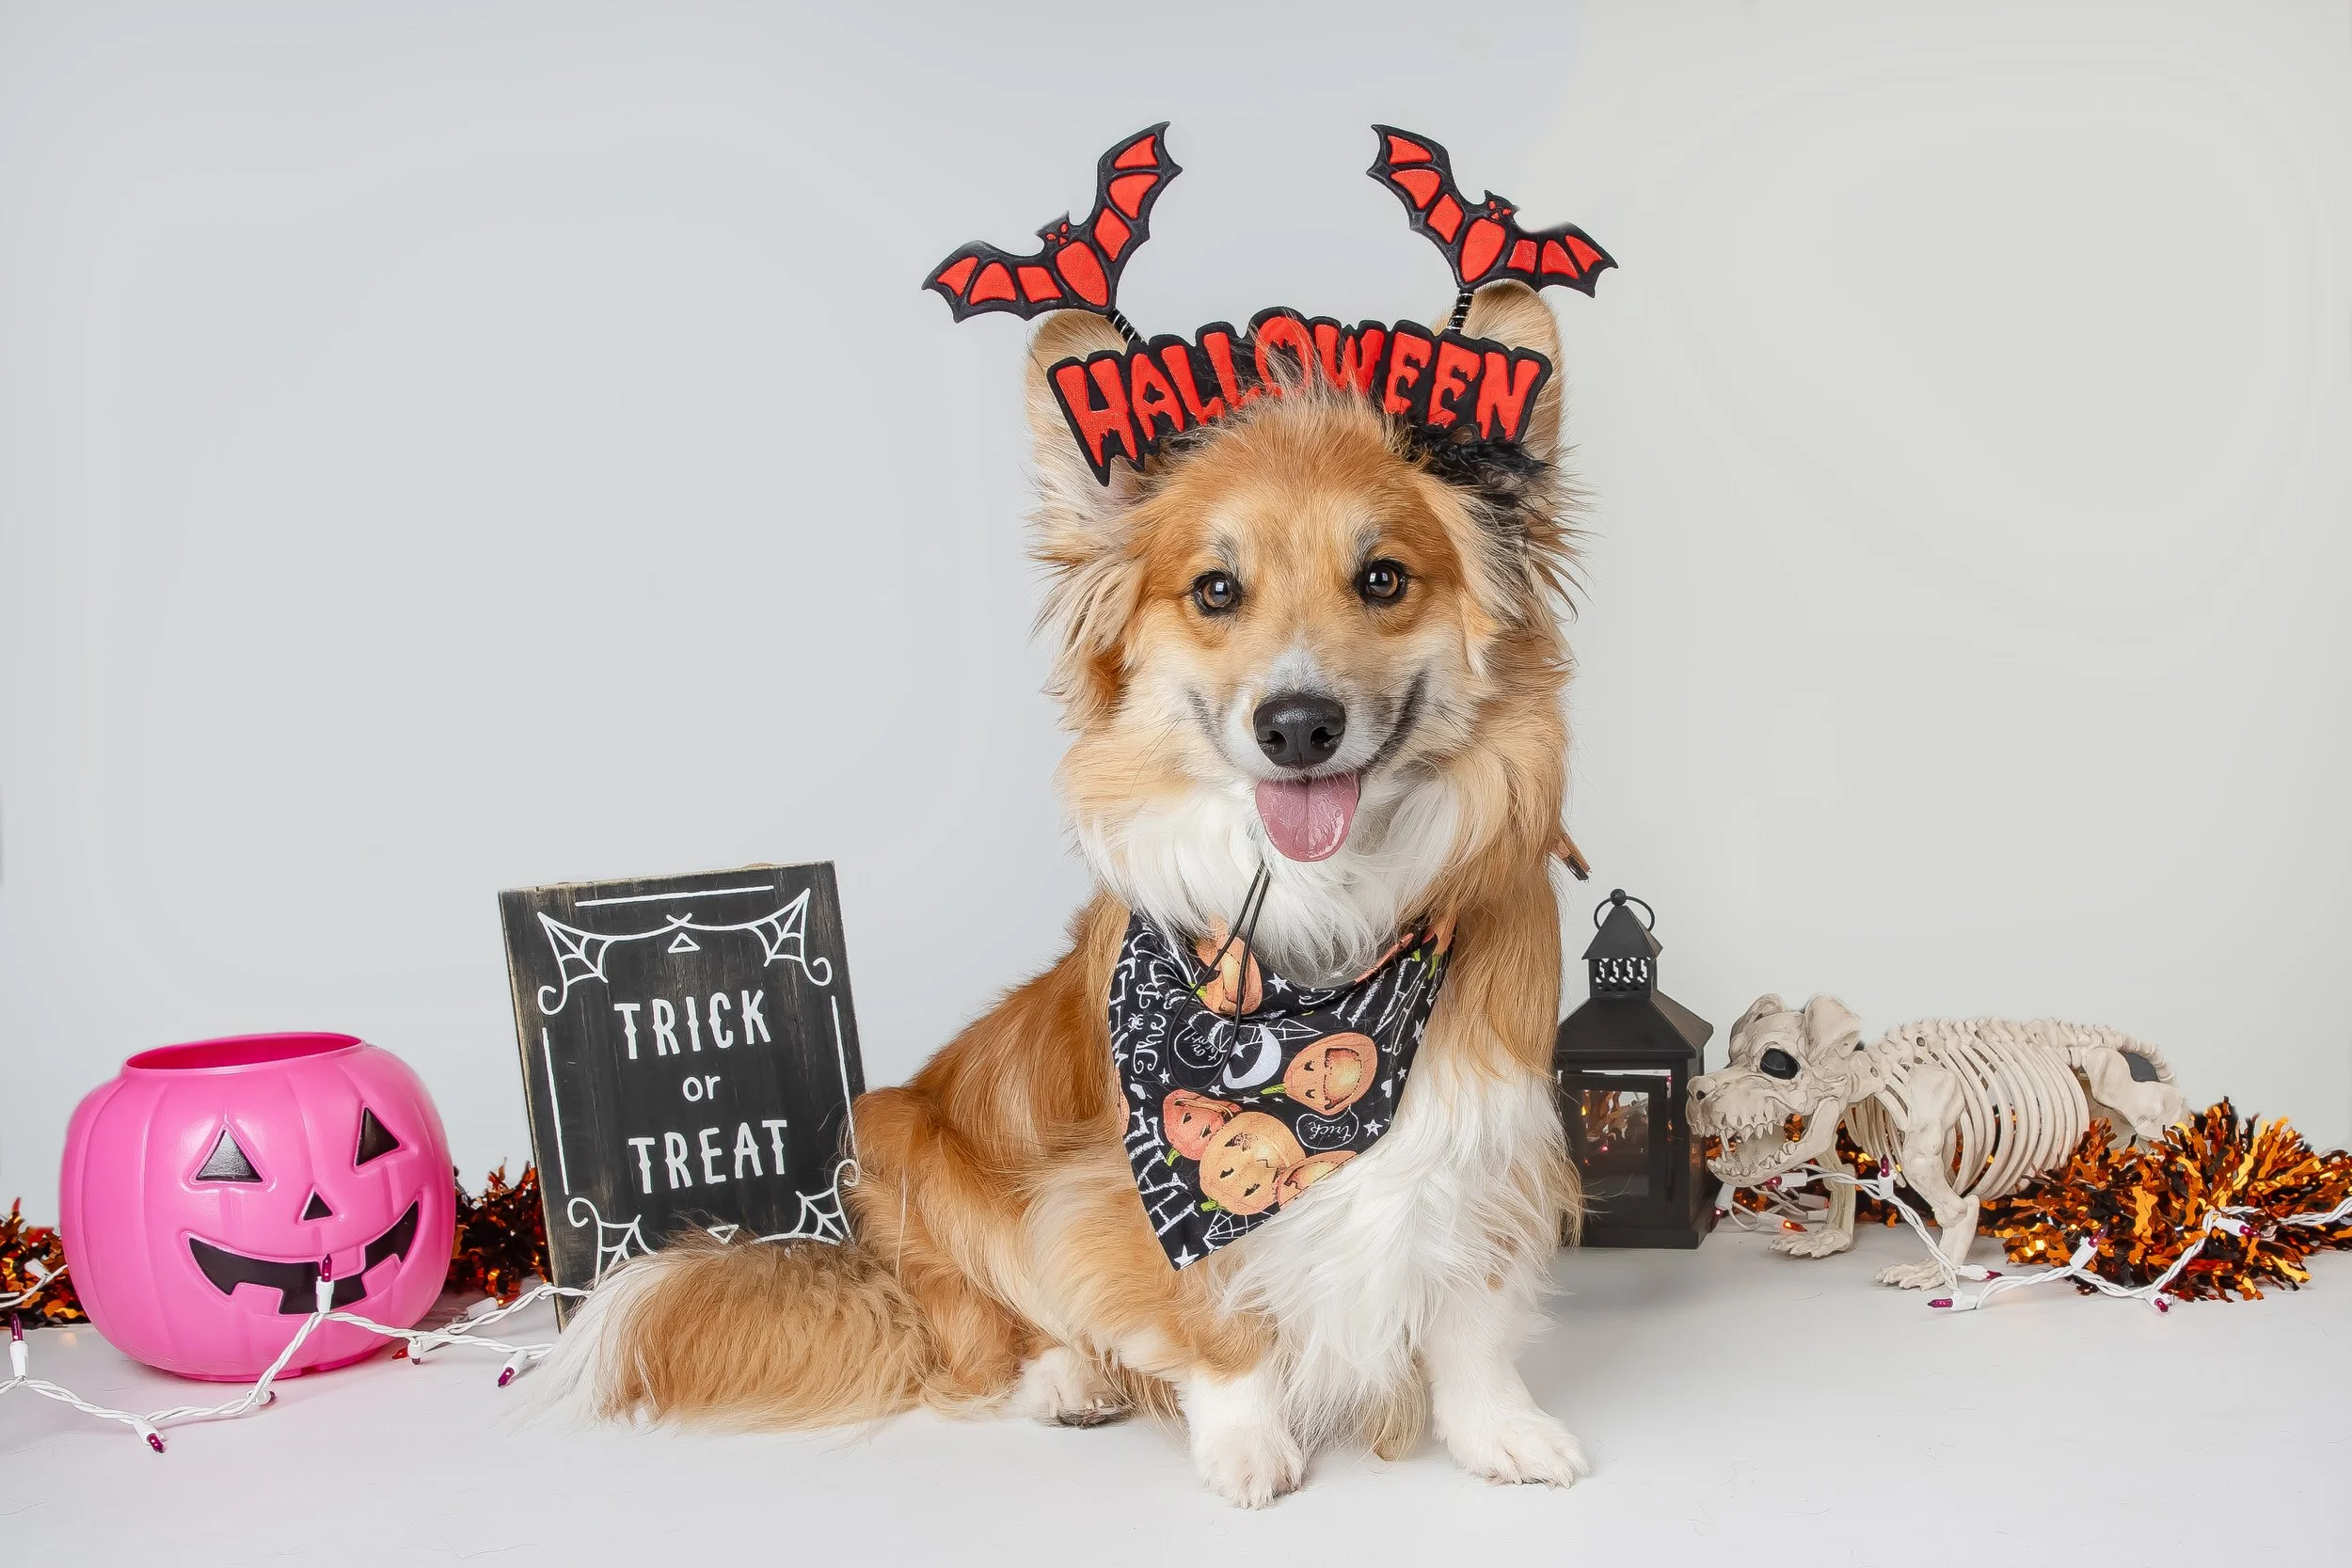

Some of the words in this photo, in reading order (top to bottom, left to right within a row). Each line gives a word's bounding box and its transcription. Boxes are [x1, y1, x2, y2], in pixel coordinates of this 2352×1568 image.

[1054, 313, 1543, 469] HALLOWEEN
[613, 990, 772, 1060] TRICK
[1133, 1013, 1167, 1074] The
[682, 1075, 722, 1102] or
[628, 1119, 788, 1195] TREAT
[1308, 1121, 1352, 1142] trick
